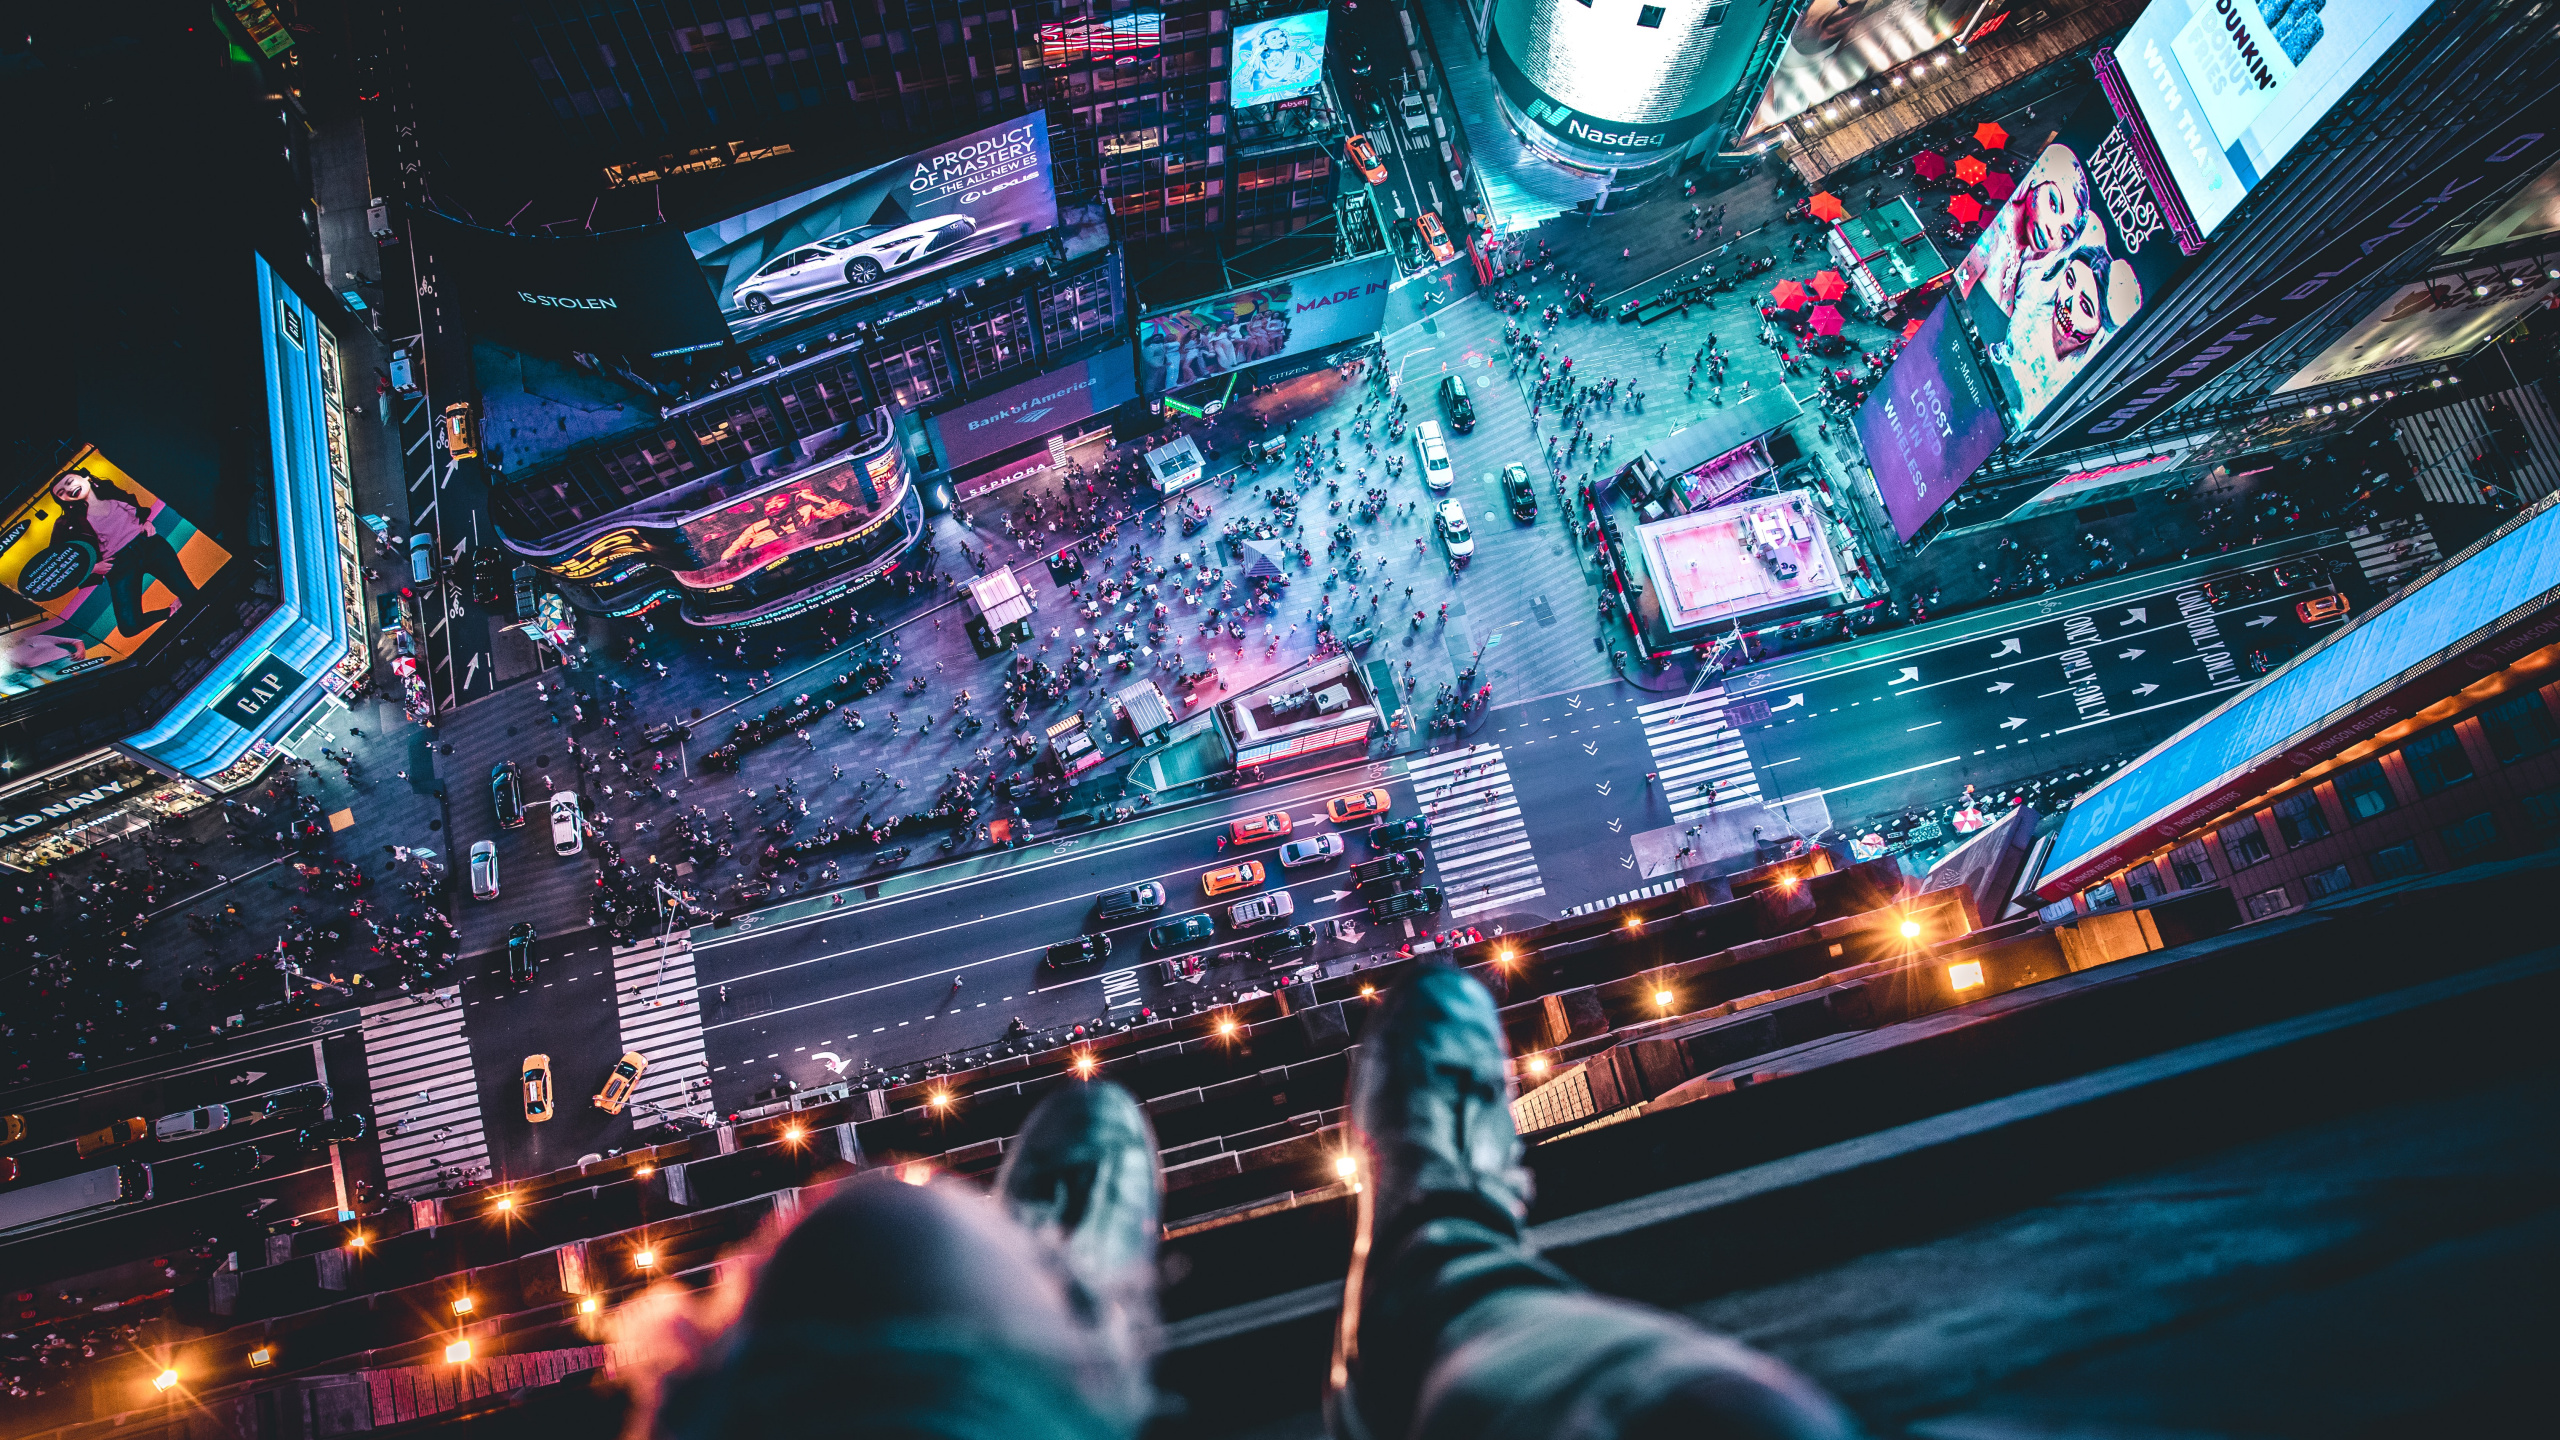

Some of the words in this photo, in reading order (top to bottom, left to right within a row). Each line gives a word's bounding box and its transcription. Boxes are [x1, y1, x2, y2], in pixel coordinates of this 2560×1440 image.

[2188, 26, 2227, 95] FRIES
[2202, 9, 2253, 96] DONUT
[2144, 38, 2182, 111] WITH
[914, 162, 930, 177] A
[932, 124, 1033, 170] PRODUCT
[1568, 119, 1666, 148] Nasdaq
[909, 172, 938, 191] OF
[943, 137, 1035, 181] MASTERY
[940, 181, 964, 195] THE
[966, 160, 1020, 187] ALL-NEW
[1023, 154, 1038, 166] ES
[981, 171, 1039, 196] LEXUS
[2086, 144, 2145, 254] MAKERS
[2102, 126, 2165, 241] FANTASY
[517, 290, 537, 304] IS
[536, 295, 617, 309] STOLEN
[1296, 286, 1361, 314] MADE
[1365, 279, 1387, 295] IN
[2088, 383, 2182, 434] CALL
[2166, 314, 2277, 377] DUTY
[2282, 174, 2485, 300] BLACK
[287, 311, 299, 338] GAP
[1268, 365, 1310, 381] CITIZEN
[2357, 359, 2382, 373] THE
[968, 409, 1010, 431] Bank
[1011, 401, 1028, 415] of
[1030, 377, 1097, 408] America
[1923, 379, 1952, 438] MOST
[1909, 422, 1923, 448] IN
[1910, 388, 1942, 457] LOVED
[969, 463, 1046, 497] SEPHORA
[2, 523, 25, 546] NAVY
[814, 540, 845, 552] NOW
[847, 533, 861, 543] ON
[25, 561, 58, 591] ROCKSTAR
[56, 547, 73, 563] WITH
[28, 551, 58, 578] introducing
[32, 551, 80, 595] SECRET-SLIM
[45, 562, 80, 593] POCKETS
[864, 558, 897, 580] NEWS
[643, 589, 667, 606] actor
[729, 616, 763, 629] played
[806, 594, 824, 605] has
[825, 584, 847, 597] died
[774, 607, 808, 623] helped
[820, 592, 845, 606] unite
[845, 577, 876, 595] Giants
[2175, 590, 2215, 619] ONLY
[2063, 616, 2101, 645] ONLY
[2186, 618, 2225, 652] ONLY
[2493, 620, 2555, 655] THOMSON
[61, 665, 81, 674] OLD
[80, 657, 105, 668] NAVY
[2201, 651, 2241, 686] ONLY
[237, 673, 283, 714] GAP
[2308, 727, 2357, 755] THOMSON
[2353, 706, 2398, 732] REUTERS
[40, 780, 124, 818] NAVY
[2174, 805, 2209, 828] THOMSON
[2206, 790, 2241, 812] REUTERS
[64, 823, 89, 836] OLD
[87, 811, 120, 828] NAVY
[2069, 864, 2098, 885] THOMSON
[2095, 854, 2123, 871] REUTERS
[1101, 970, 1142, 1011] ONLY
